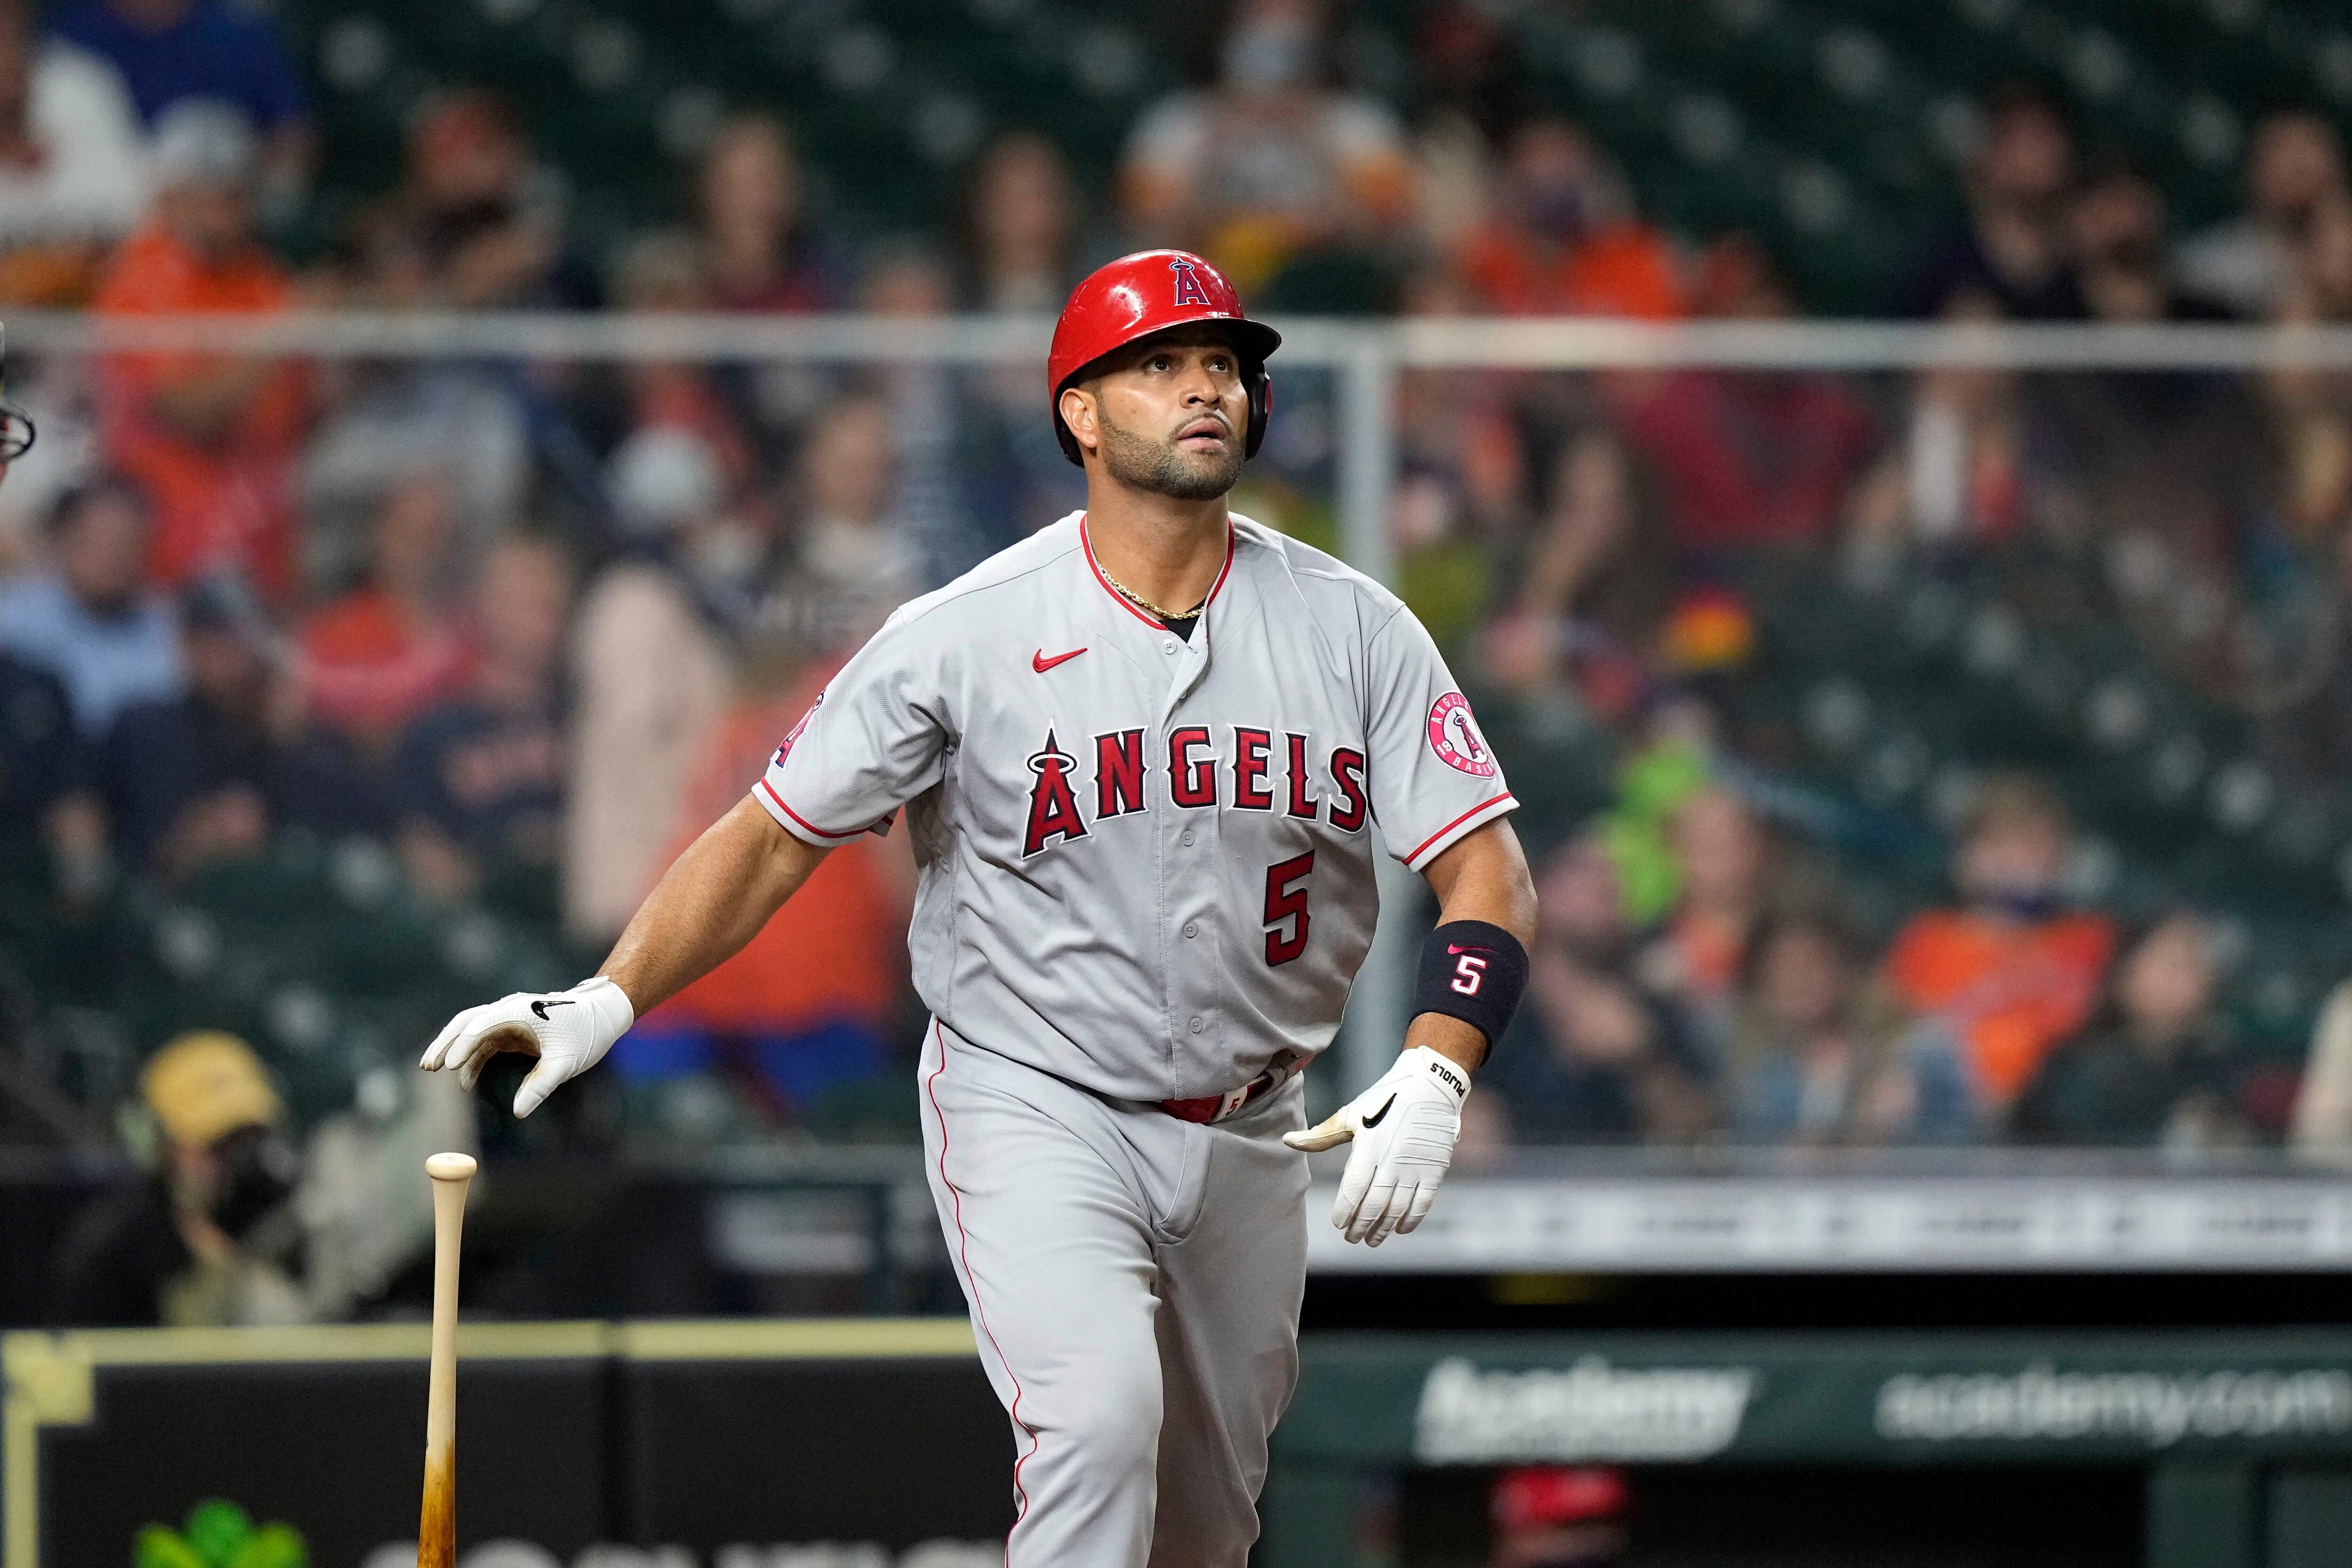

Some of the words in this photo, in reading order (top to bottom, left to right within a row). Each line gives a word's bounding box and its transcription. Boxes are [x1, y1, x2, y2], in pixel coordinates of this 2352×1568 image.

[1169, 256, 1212, 307] A
[1021, 718, 1368, 860] ANGELS
[1263, 849, 1315, 967] 5
[1451, 954, 1488, 996] 5
[1430, 1062, 1466, 1098] PUJOLS
[1225, 1097, 1240, 1116] 5
